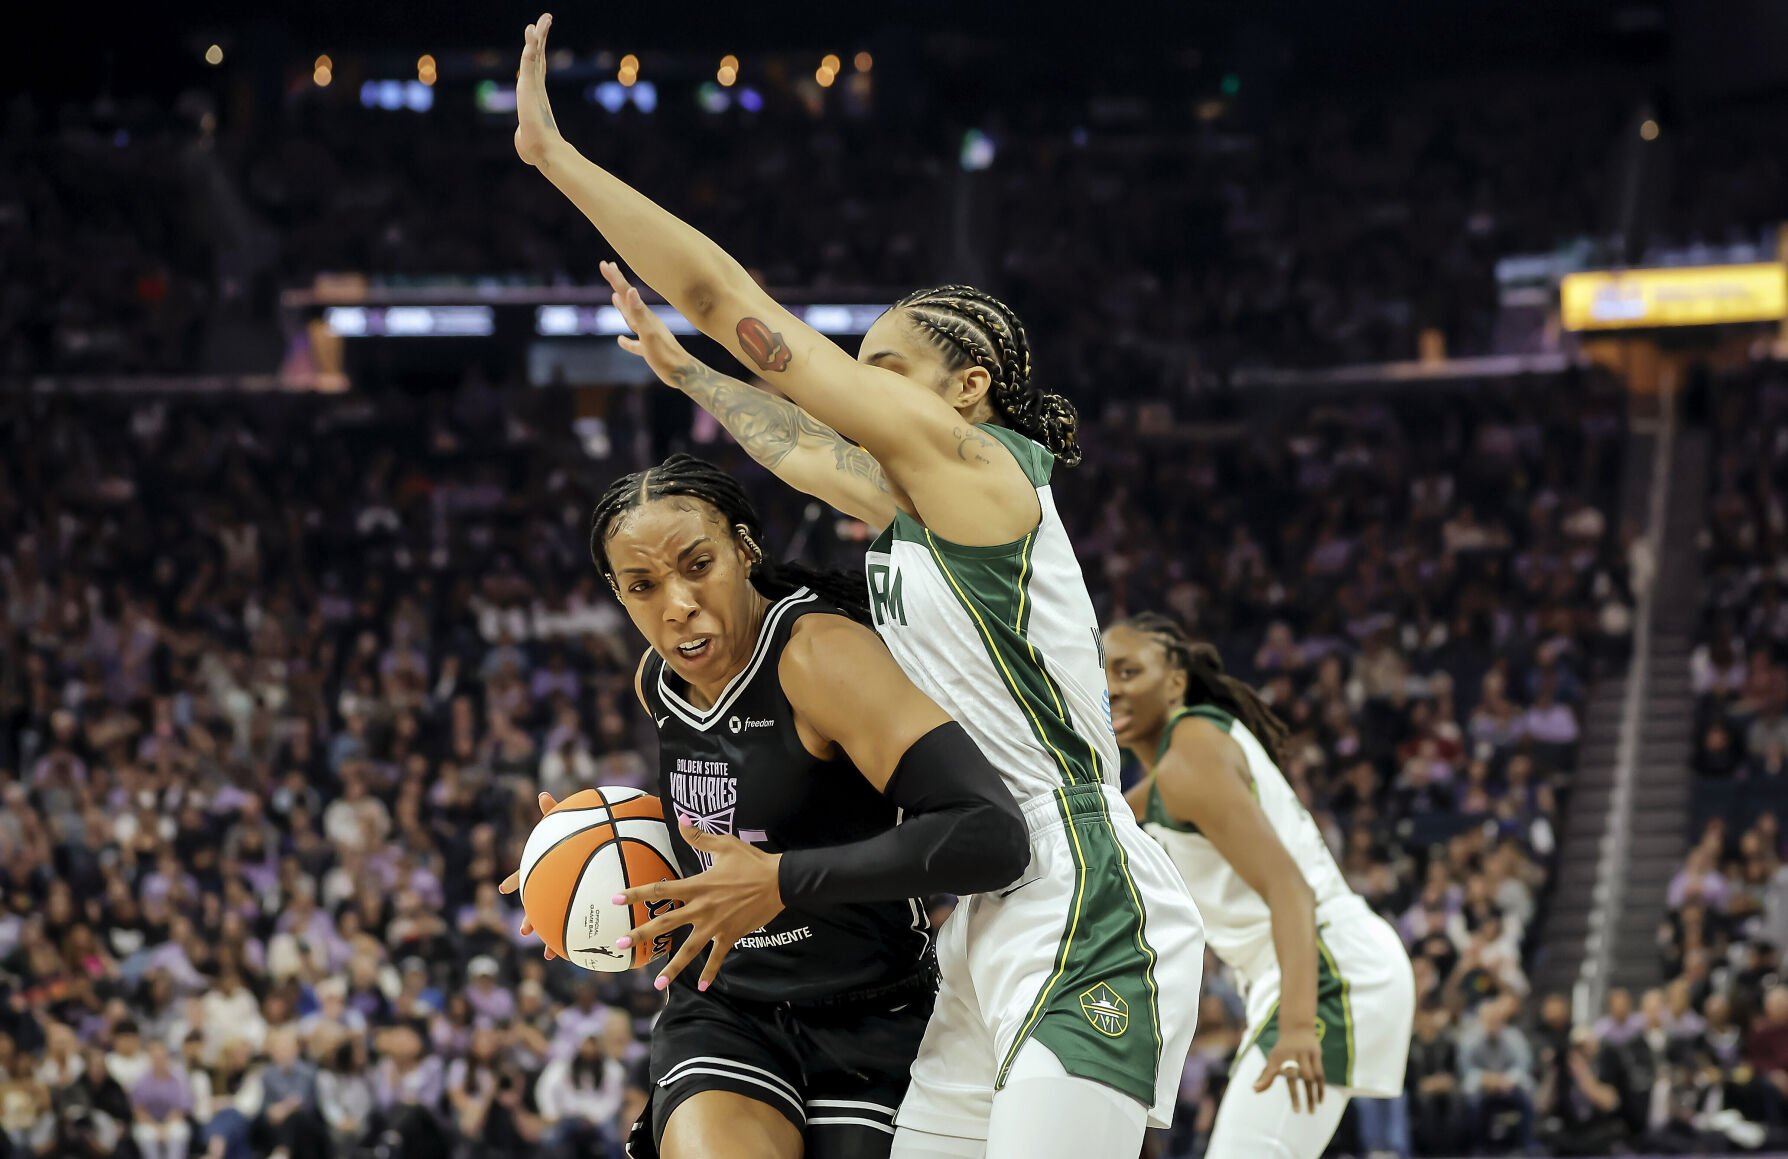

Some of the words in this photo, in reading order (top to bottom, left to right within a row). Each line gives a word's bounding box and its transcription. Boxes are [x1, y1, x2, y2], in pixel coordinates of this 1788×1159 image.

[744, 716, 774, 731] freedom
[677, 759, 702, 774] GOLDEN
[705, 761, 728, 776] STATE
[670, 772, 737, 815] VALKYRIES
